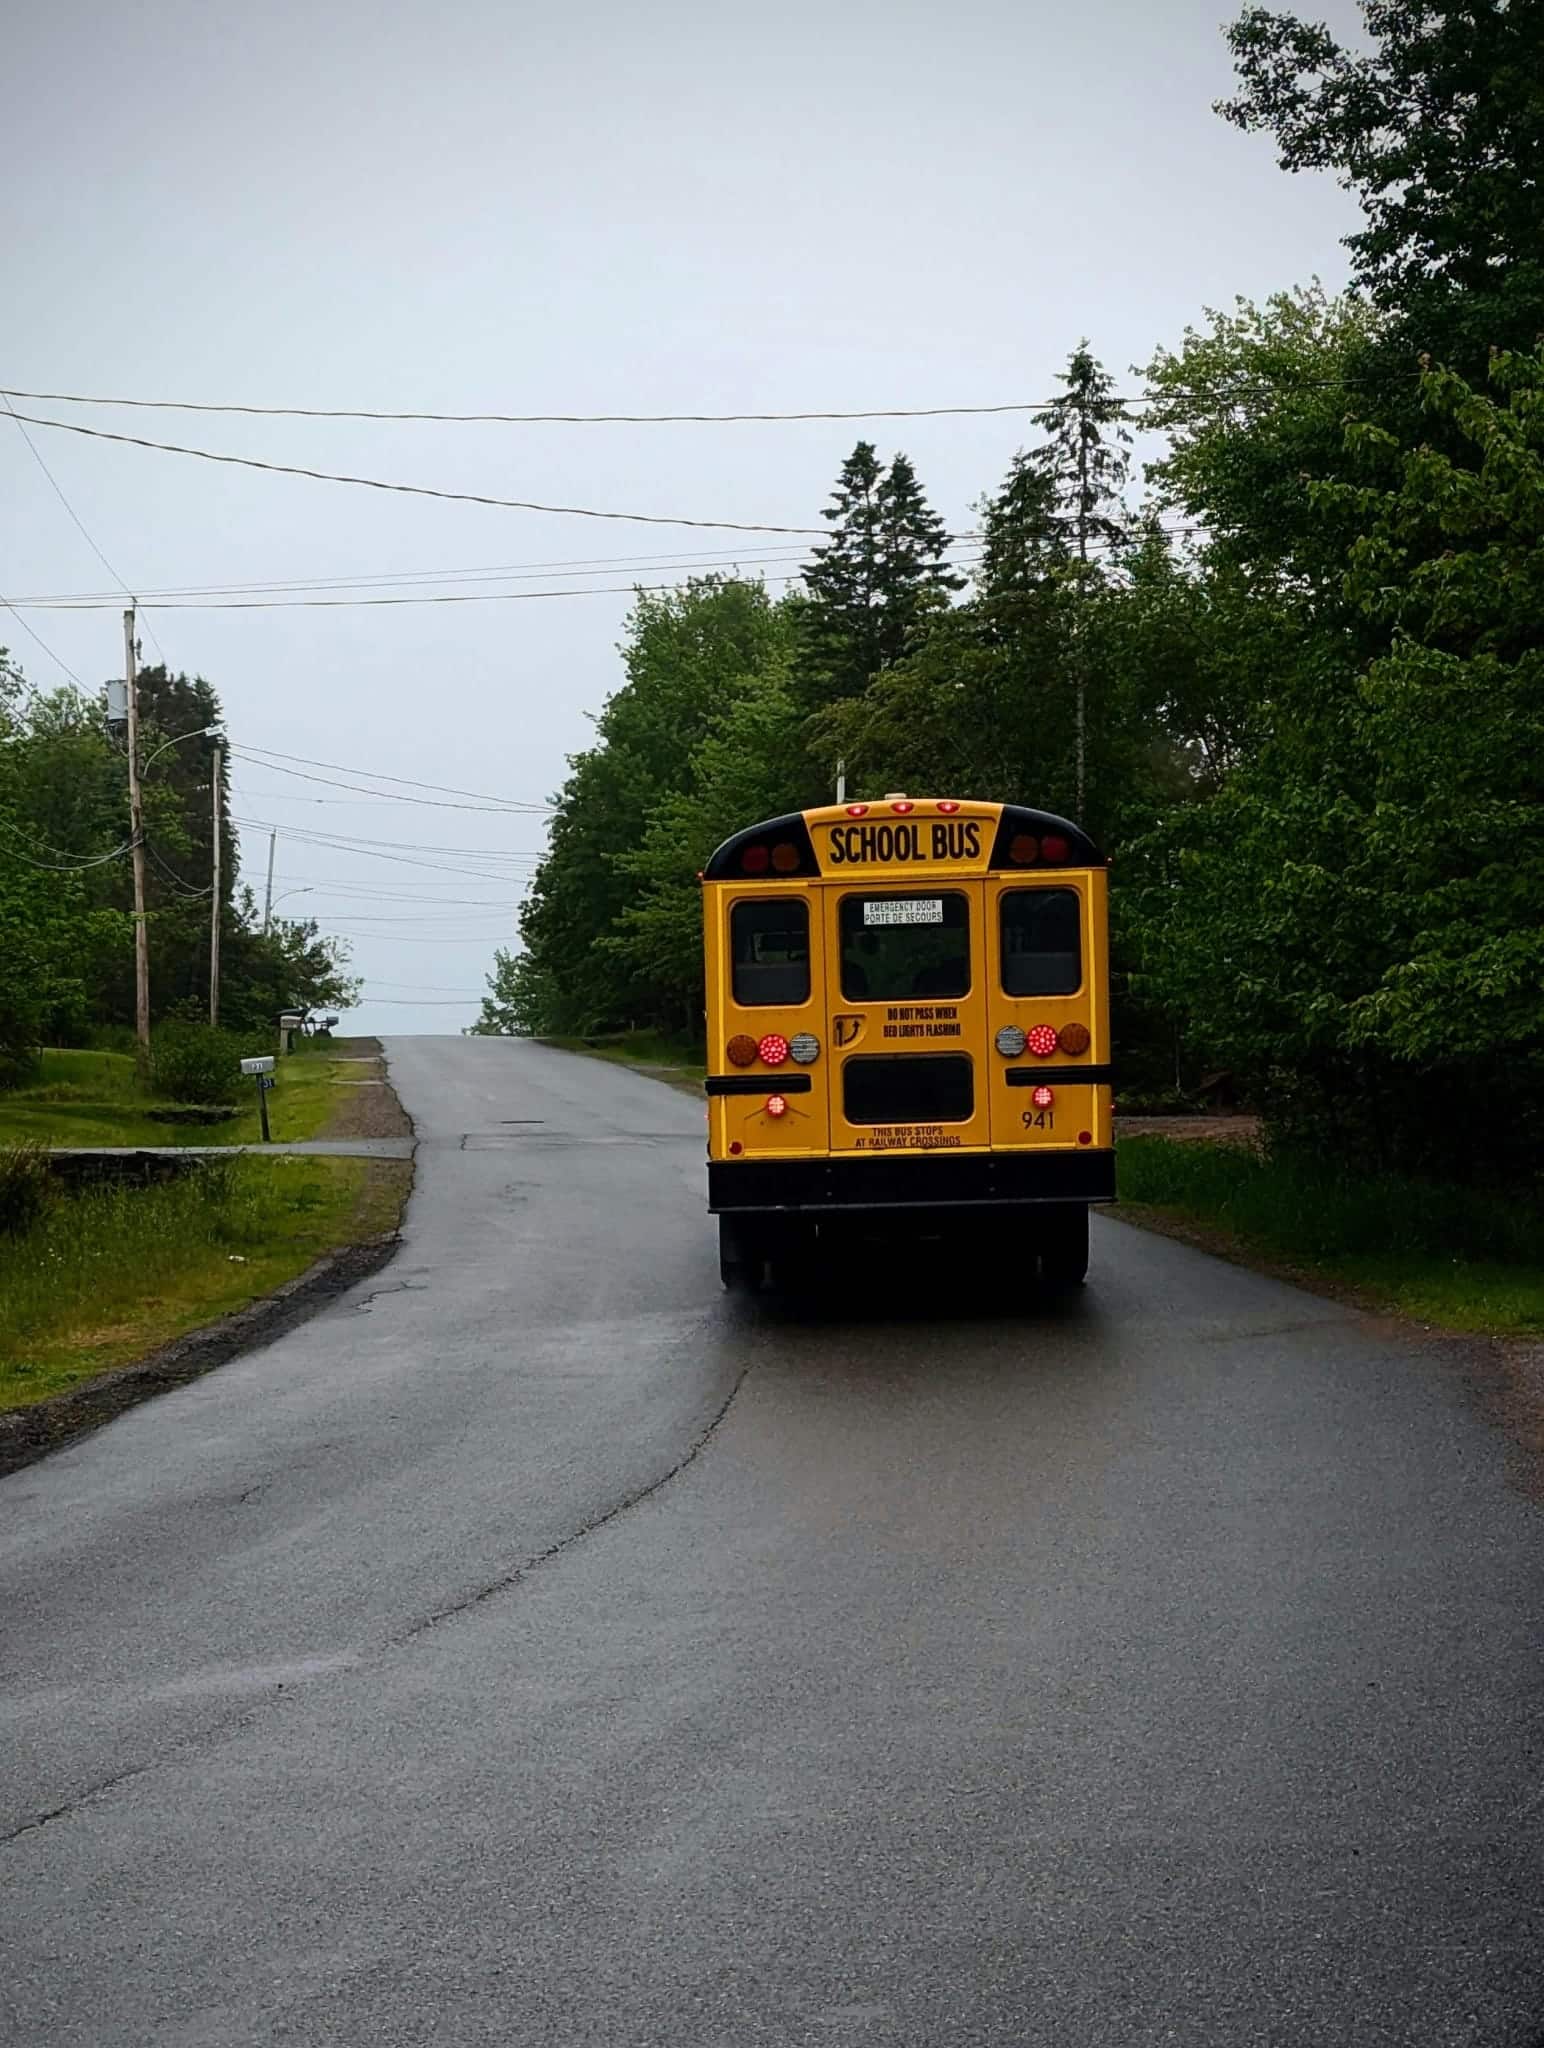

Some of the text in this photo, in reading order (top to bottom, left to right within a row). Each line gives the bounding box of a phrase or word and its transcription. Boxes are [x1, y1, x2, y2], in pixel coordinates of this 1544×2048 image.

[830, 822, 980, 863] SCHOOL BUS
[869, 901, 937, 912] EMERGENCY DOOR
[865, 912, 942, 923] PORTE DE SECOURS
[887, 1007, 957, 1020] DO NOT PASS WHEN
[883, 1024, 961, 1038] RED LIGHTS FLASHING
[1022, 1111, 1054, 1130] 941
[873, 1126, 944, 1137] THIS BUS STOPS
[856, 1136, 961, 1147] AT RAILWAY CROSSINGS
